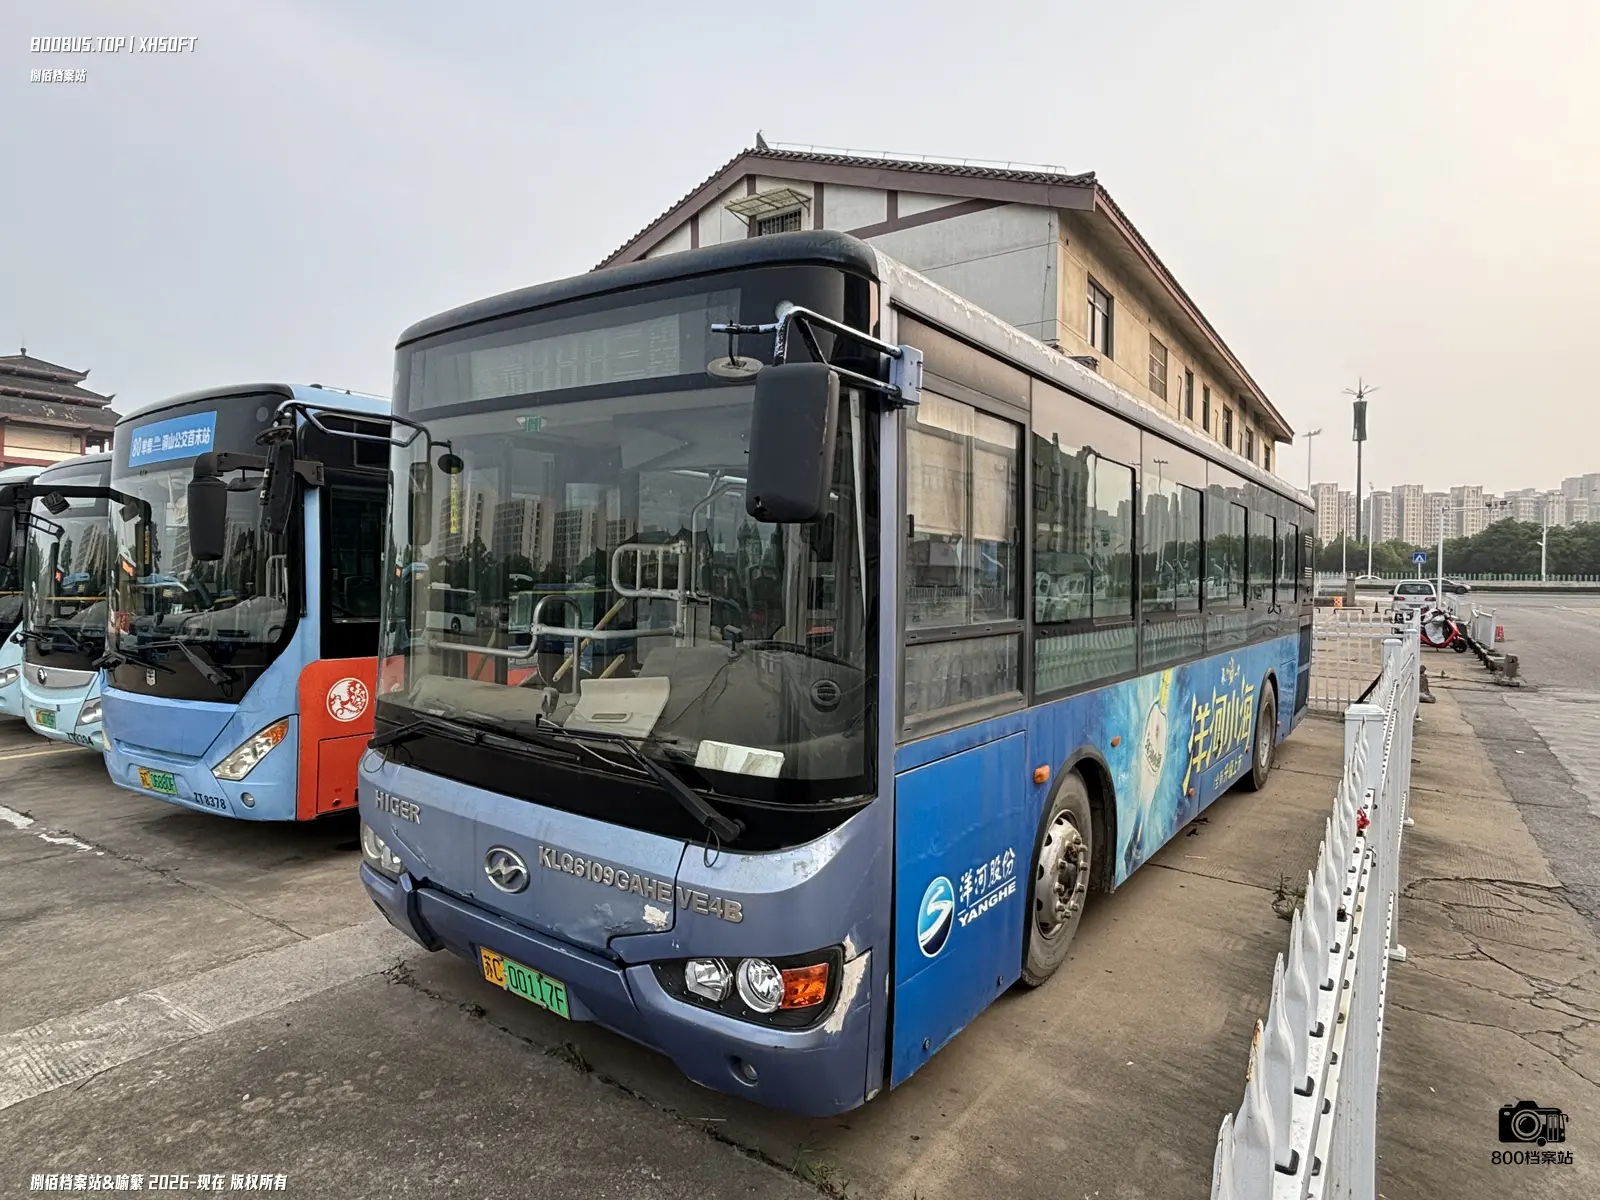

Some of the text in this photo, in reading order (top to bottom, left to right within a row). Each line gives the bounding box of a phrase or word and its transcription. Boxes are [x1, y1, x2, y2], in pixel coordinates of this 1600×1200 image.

[193, 791, 227, 811] ZT8378
[374, 789, 421, 825] HIGER
[959, 847, 1016, 908] 洋河股份
[958, 880, 1017, 928] YANGHE
